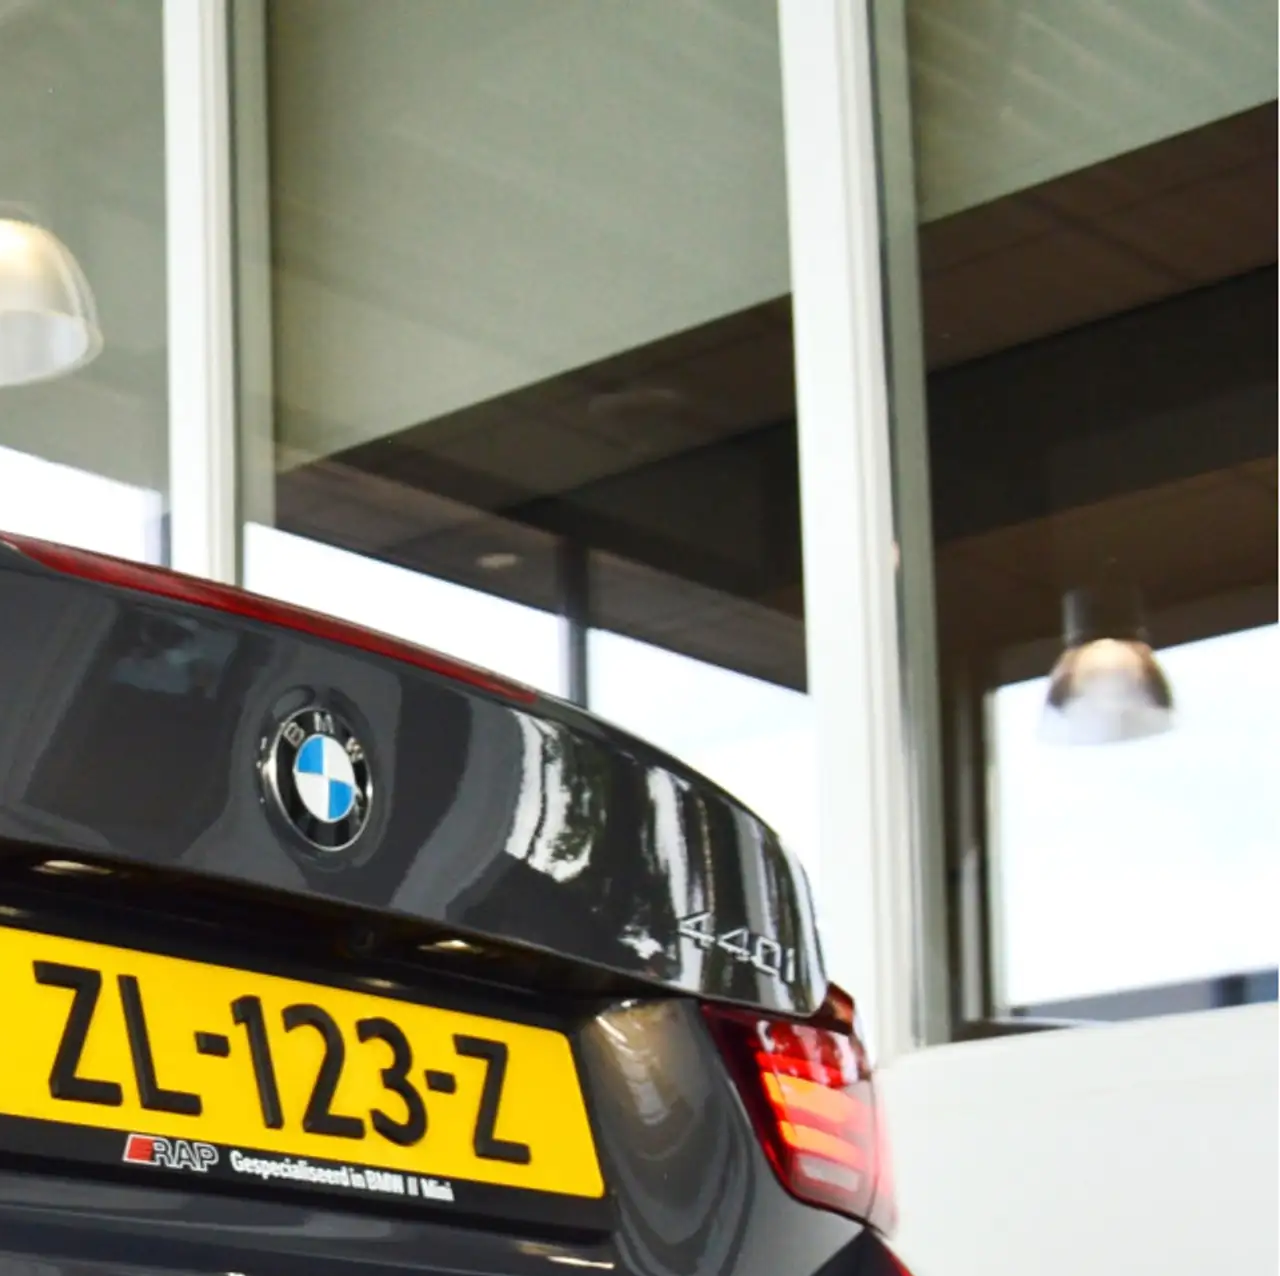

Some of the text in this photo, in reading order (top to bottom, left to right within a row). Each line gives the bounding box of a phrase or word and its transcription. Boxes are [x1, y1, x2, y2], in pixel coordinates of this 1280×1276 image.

[283, 711, 364, 764] BMW
[678, 911, 795, 983] 440i
[32, 959, 531, 1165] ZL-123-Z
[151, 1136, 220, 1173] RAP
[229, 1150, 350, 1187] Gespecialiseerd
[348, 1167, 366, 1189] in
[364, 1168, 405, 1195] BMW
[420, 1177, 455, 1201] Mini
